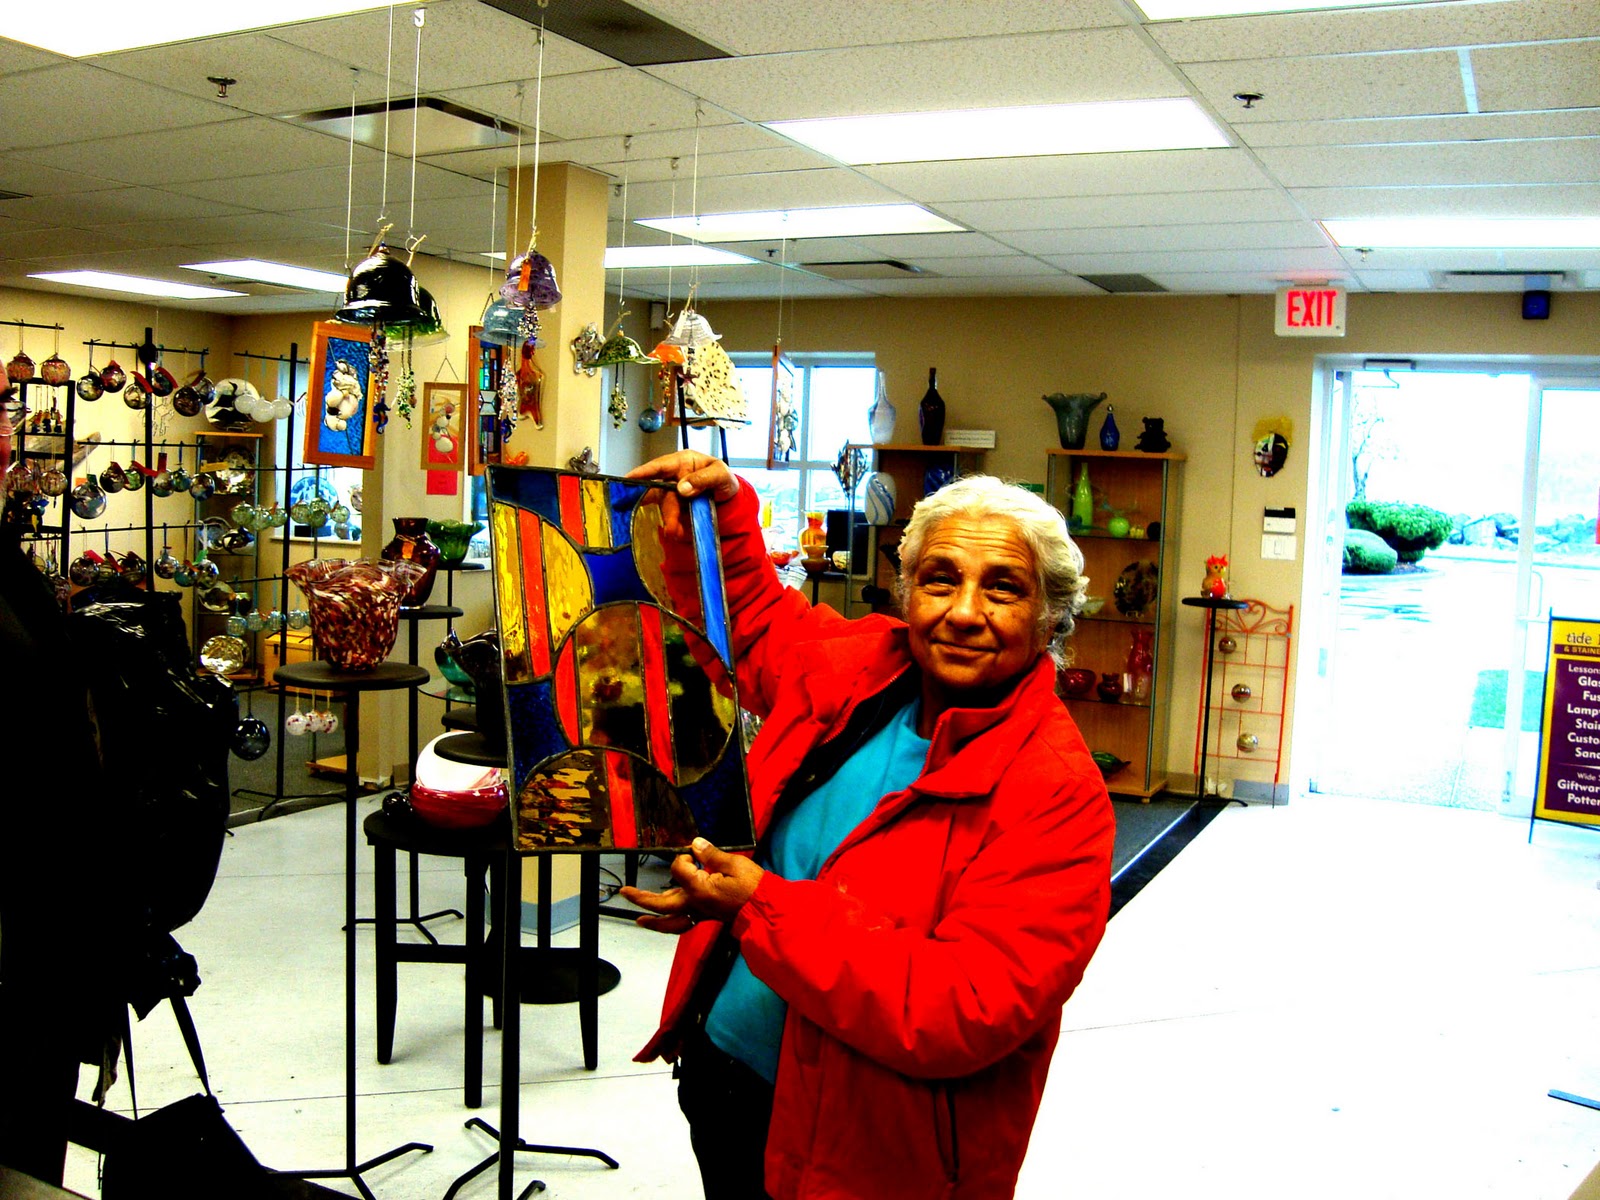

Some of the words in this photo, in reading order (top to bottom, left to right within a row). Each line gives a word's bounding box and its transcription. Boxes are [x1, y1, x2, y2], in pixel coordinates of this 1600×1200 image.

[1287, 291, 1337, 327] EXIT
[1566, 632, 1592, 645] tide
[1567, 703, 1600, 718] Lamp
[1567, 732, 1600, 745] Custo
[1577, 772, 1596, 781] Wide
